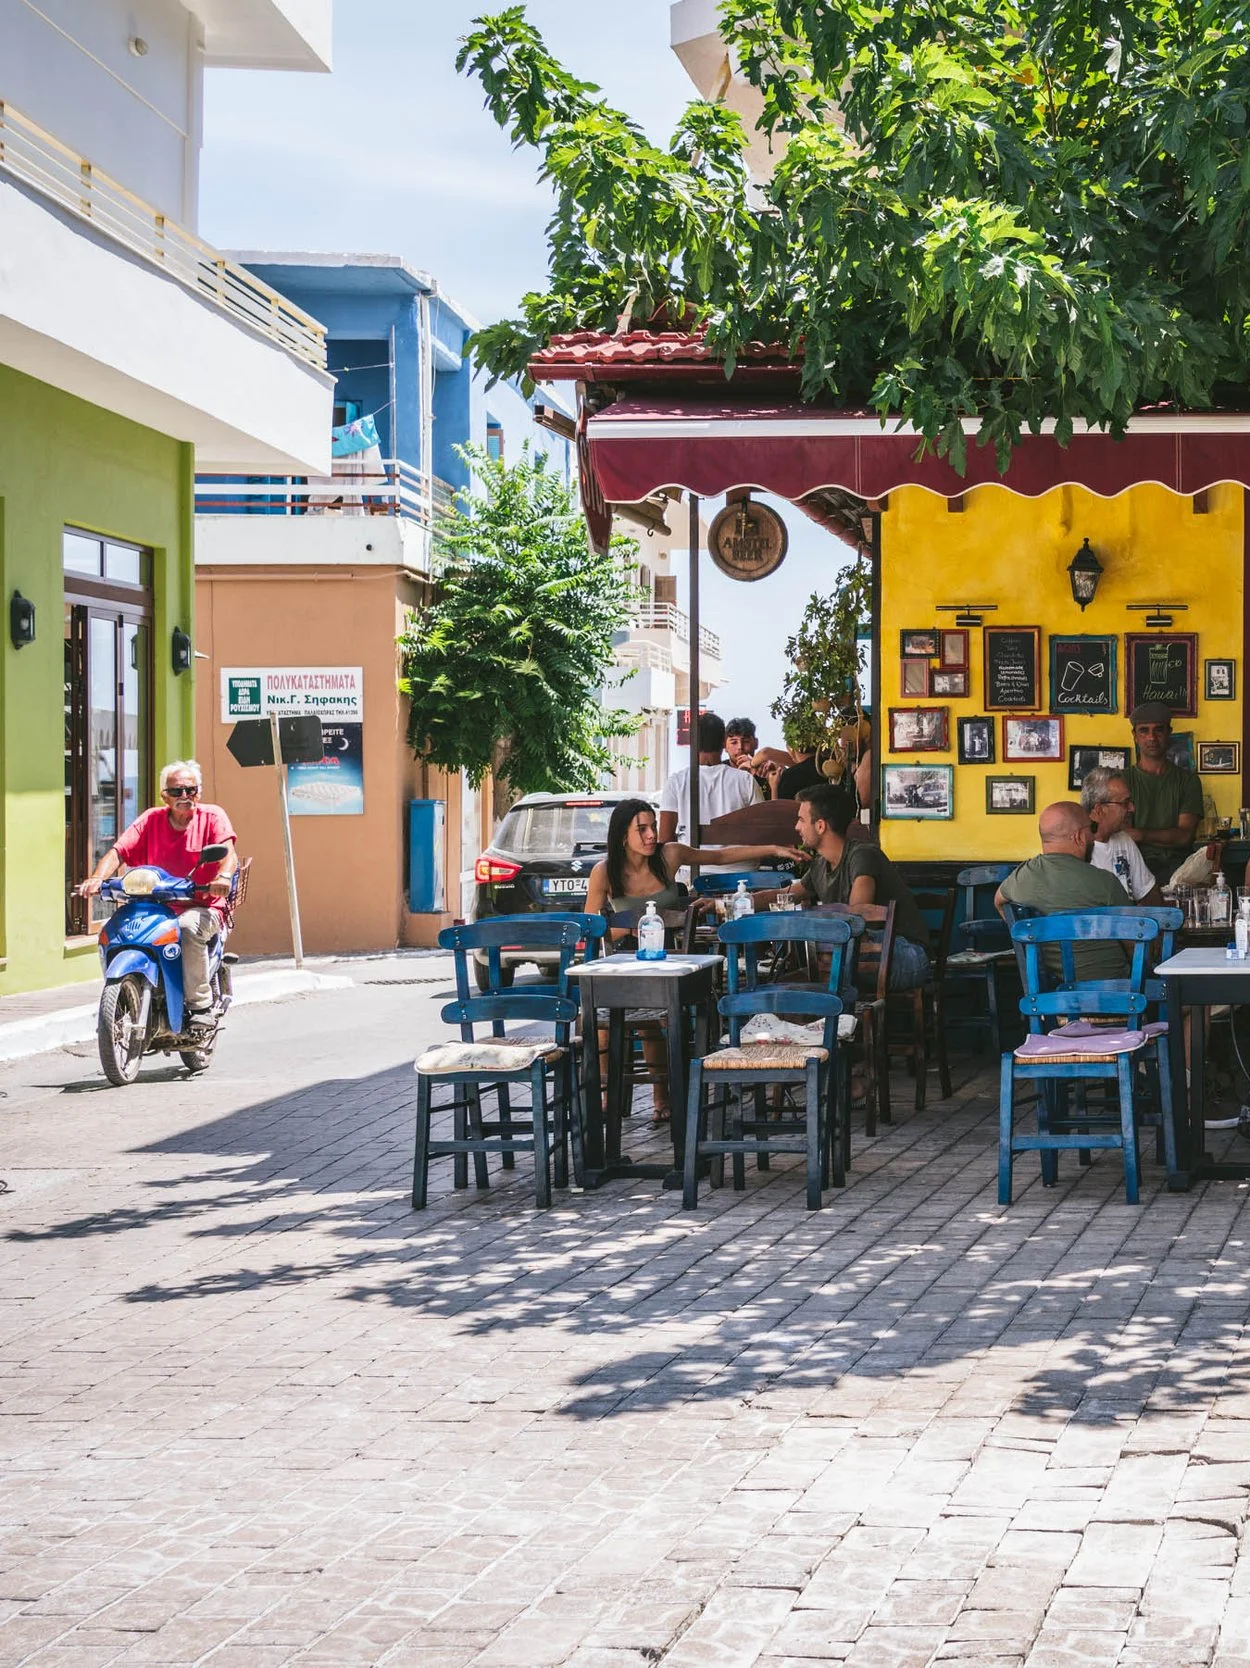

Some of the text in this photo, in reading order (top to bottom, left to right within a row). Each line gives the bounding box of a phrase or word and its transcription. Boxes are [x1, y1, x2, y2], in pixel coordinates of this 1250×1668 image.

[267, 675, 356, 689] ΠΟΛΥΚΑΤΑΣΤΗΜΑΤΑ
[304, 694, 358, 707] Σηφακης
[1057, 691, 1109, 705] Cocktails
[552, 879, 588, 892] YTO-4
